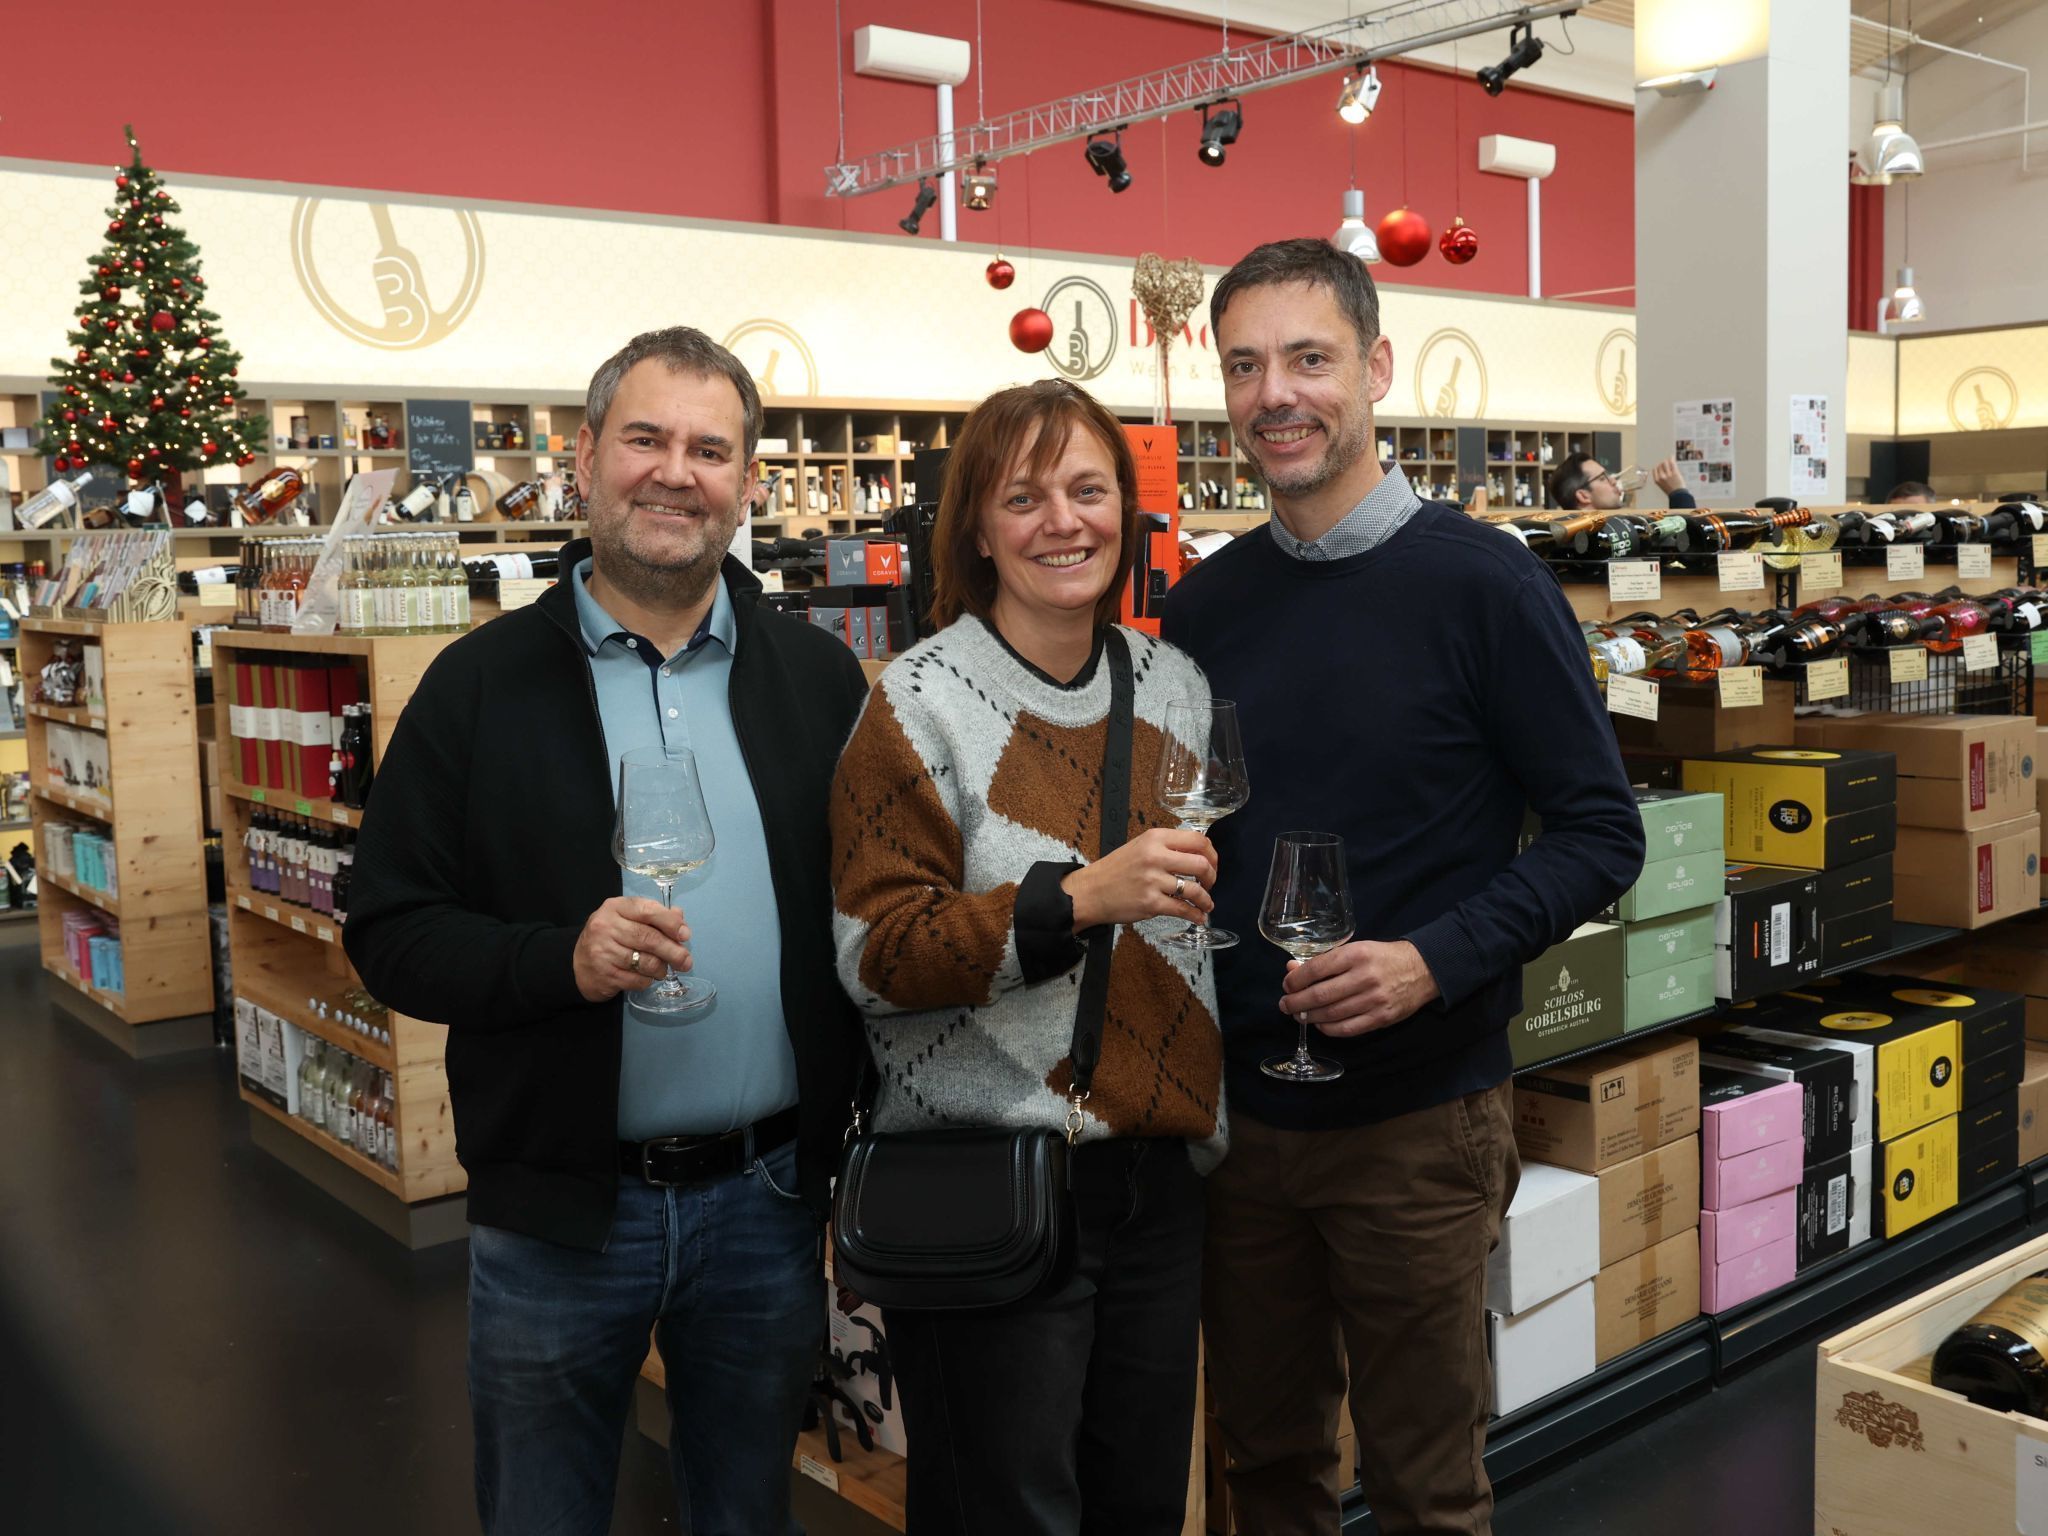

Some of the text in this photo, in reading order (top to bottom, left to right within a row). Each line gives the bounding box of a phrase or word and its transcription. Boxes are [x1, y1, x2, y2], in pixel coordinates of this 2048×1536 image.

[1130, 361, 1178, 378] Wen
[1667, 879, 1694, 890] SOLIGO
[1544, 989, 1585, 1011] SCHLOSS
[1525, 997, 1601, 1032] GOBELSBURG
[1569, 1017, 1590, 1029] AUSTRIA
